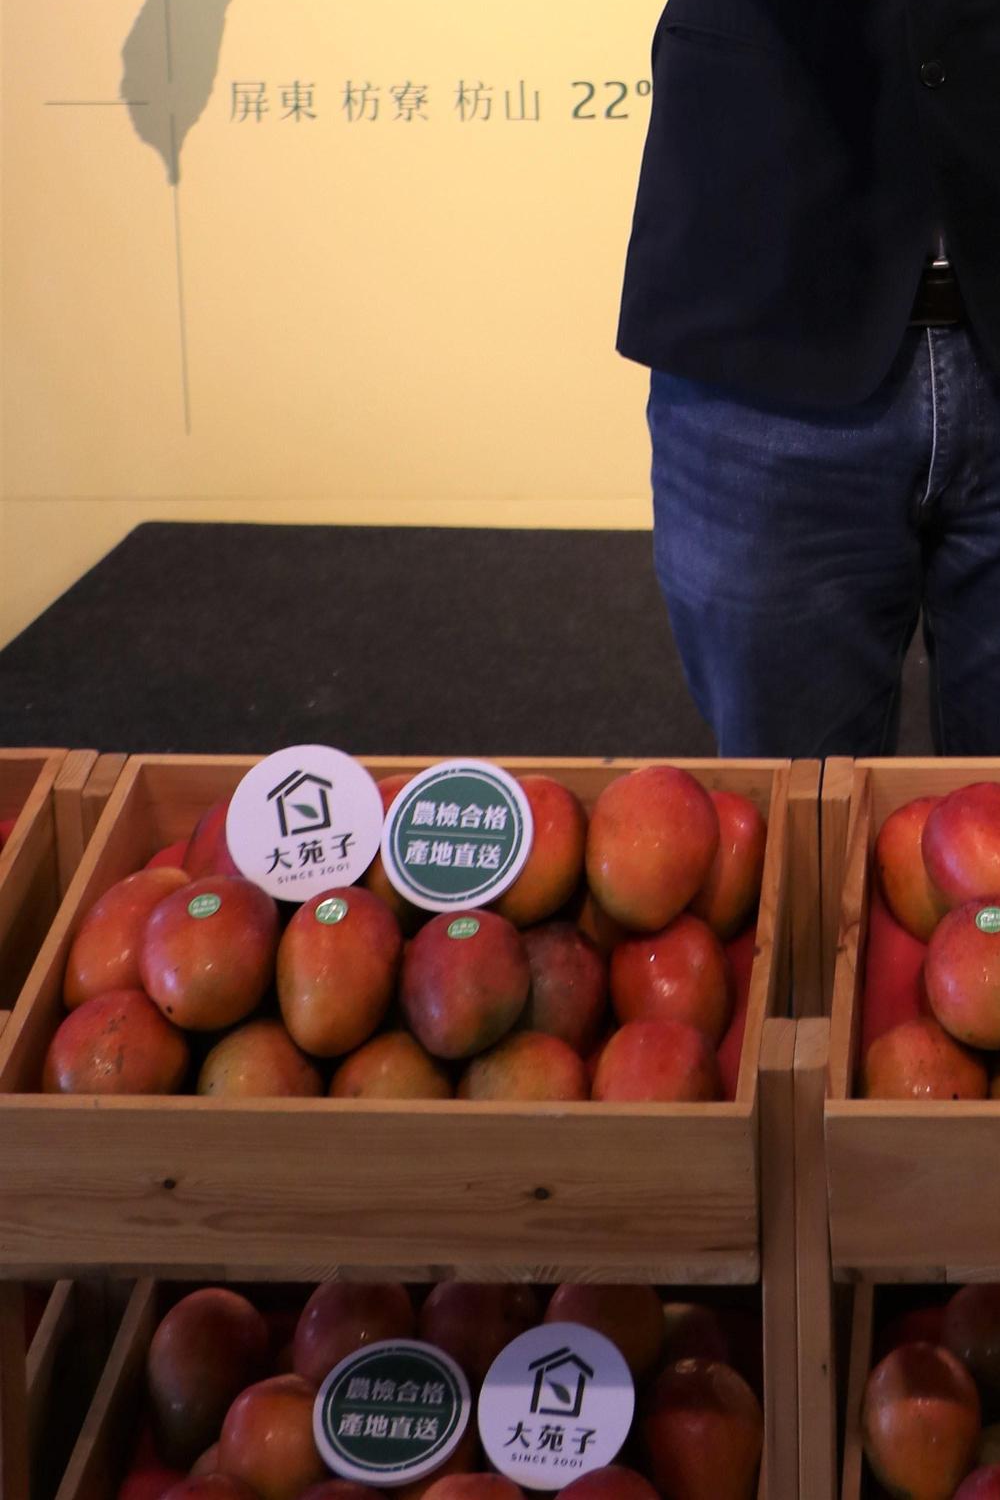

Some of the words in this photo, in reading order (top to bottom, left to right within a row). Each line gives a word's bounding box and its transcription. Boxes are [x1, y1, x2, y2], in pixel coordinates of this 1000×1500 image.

[228, 79, 318, 123] 屏東
[340, 79, 429, 123] 枋寮
[455, 79, 542, 123] 枋山
[411, 800, 508, 831] 農檢合格
[265, 832, 356, 874] 大苑子
[404, 839, 502, 869] 產地直送
[278, 870, 314, 885] SINCE
[320, 862, 351, 876] 2001
[346, 1377, 446, 1405] 農檢合格
[338, 1413, 438, 1441] 產地直送
[503, 1421, 597, 1455] 大苑子
[509, 1453, 547, 1466] SINCE
[552, 1458, 584, 1469] 2001
